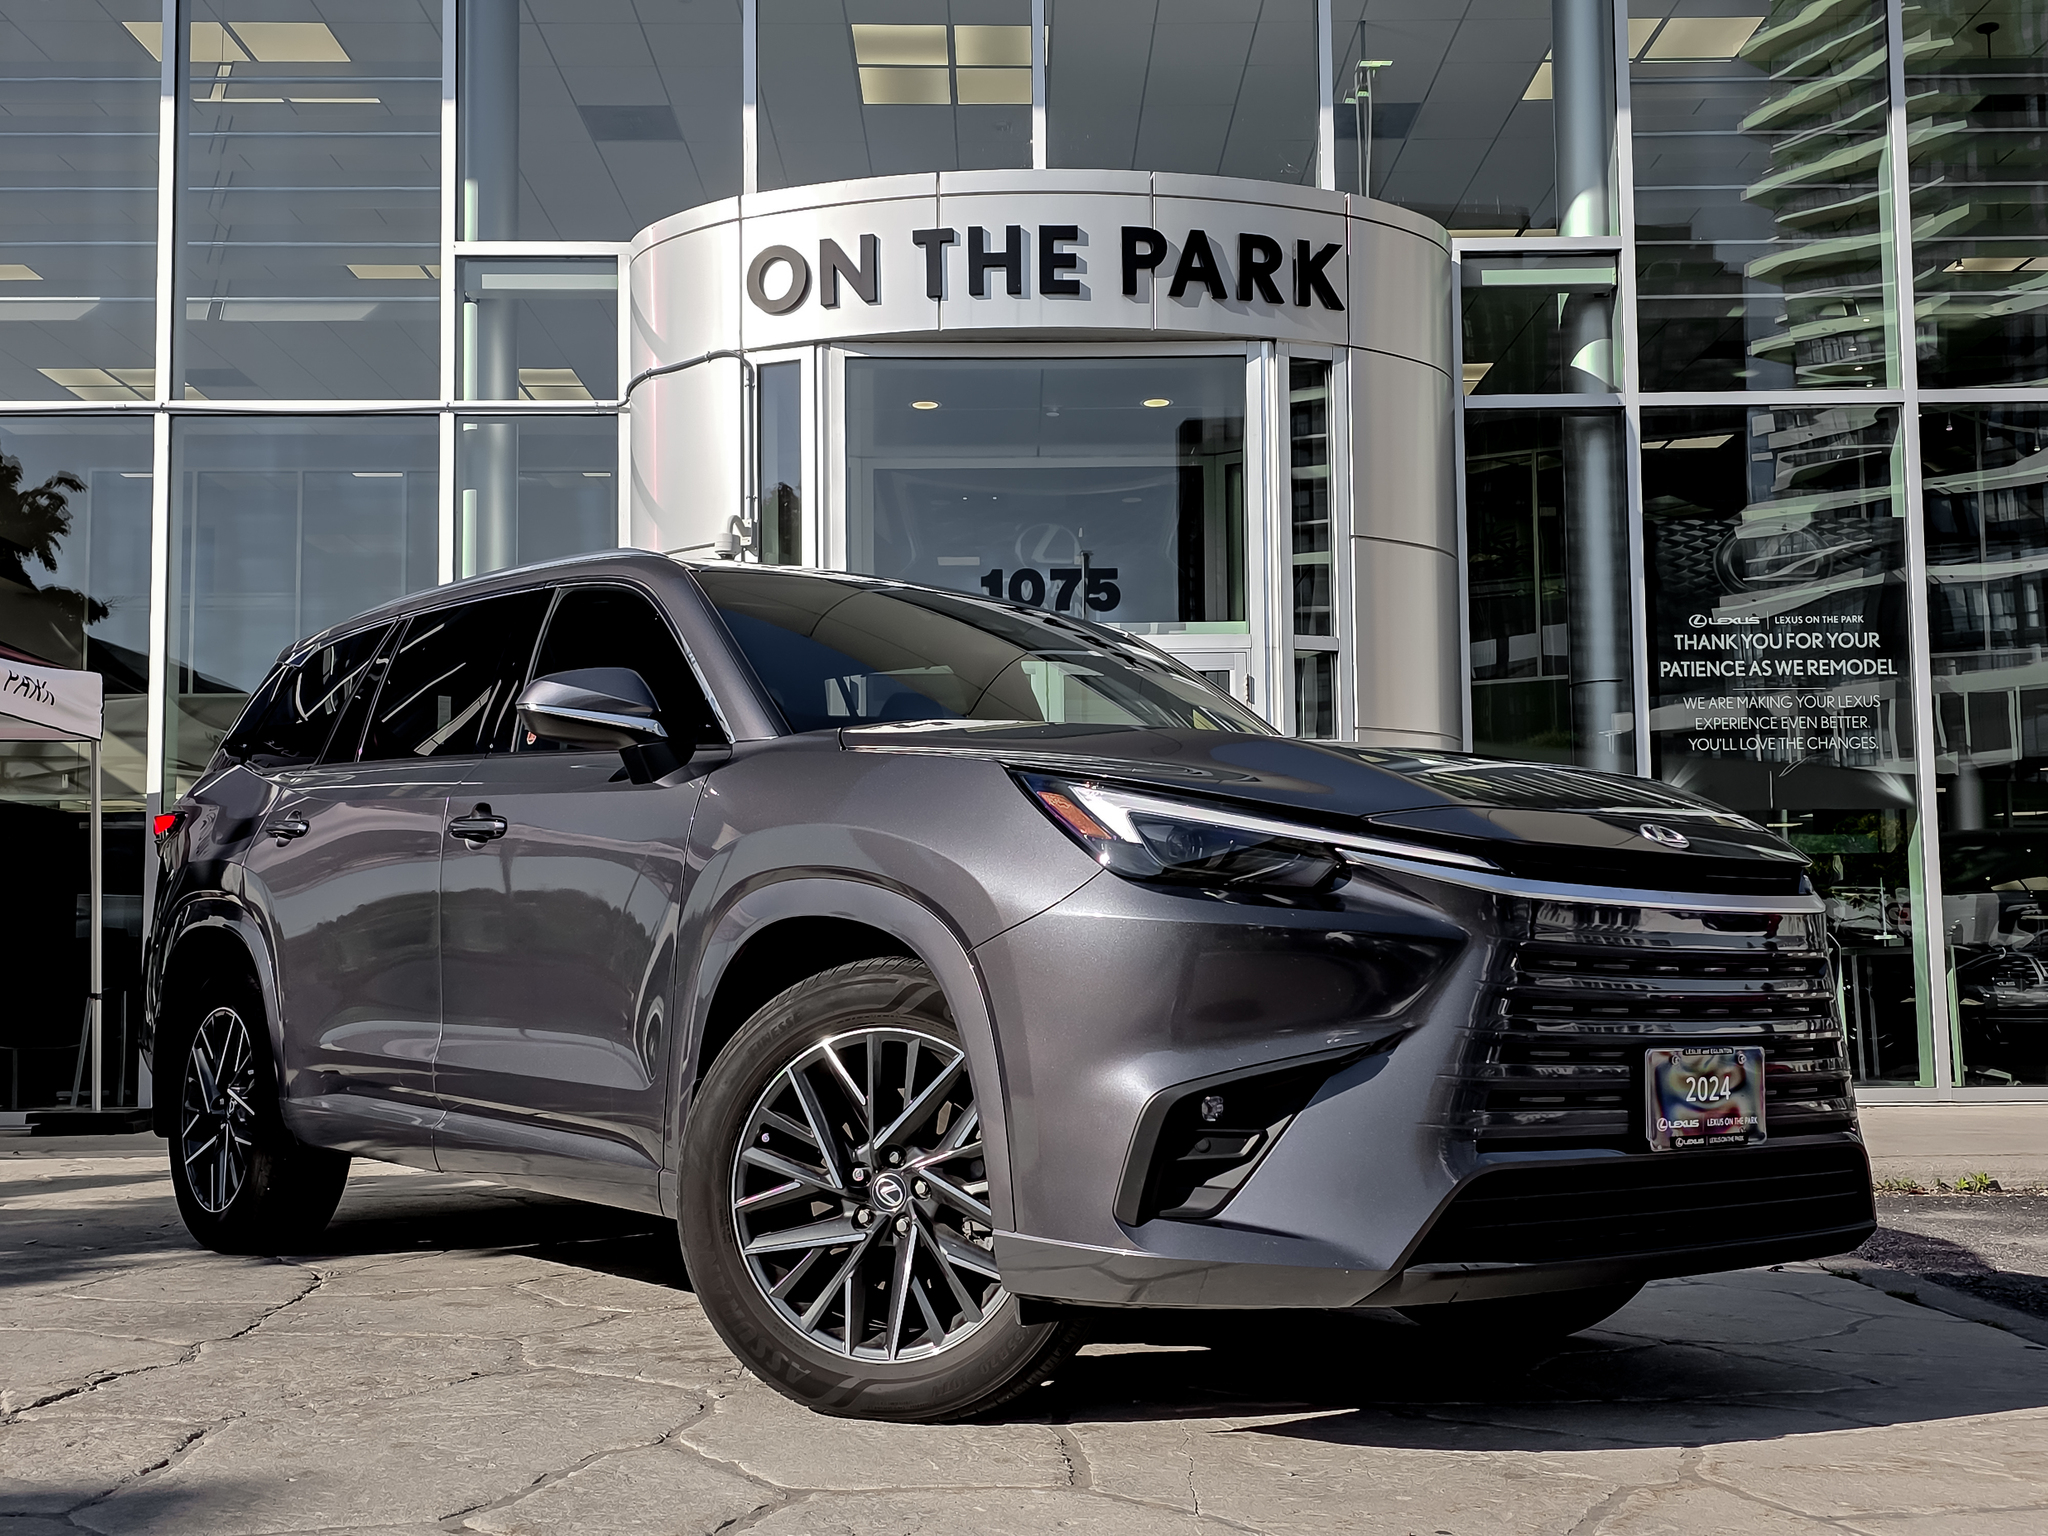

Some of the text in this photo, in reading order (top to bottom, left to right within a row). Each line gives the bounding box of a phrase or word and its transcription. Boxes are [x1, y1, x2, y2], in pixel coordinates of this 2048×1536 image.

[747, 224, 1346, 316] ON THE PARK
[980, 568, 1121, 612] 1075
[1708, 616, 1760, 626] LEXUS
[1774, 615, 1865, 625] LEXUS ON THE PARK
[1674, 631, 1881, 651] THANK YOU FOR YOUR
[1660, 658, 1898, 678] PATIENCE AS WE REMODEL
[1683, 694, 1881, 710] WE ARE MAKING YOUR LEXUS
[1695, 715, 1871, 731] EXPERIENCE EVEN BETTER.
[1688, 736, 1879, 751] YOU'LL LOVE THE CHANGES.
[746, 1010, 803, 1061] FINESSE
[1685, 1075, 1731, 1102] 2024
[1668, 1119, 1700, 1128] LEXUS
[1706, 1116, 1759, 1127] LEXUS ON THE PARK
